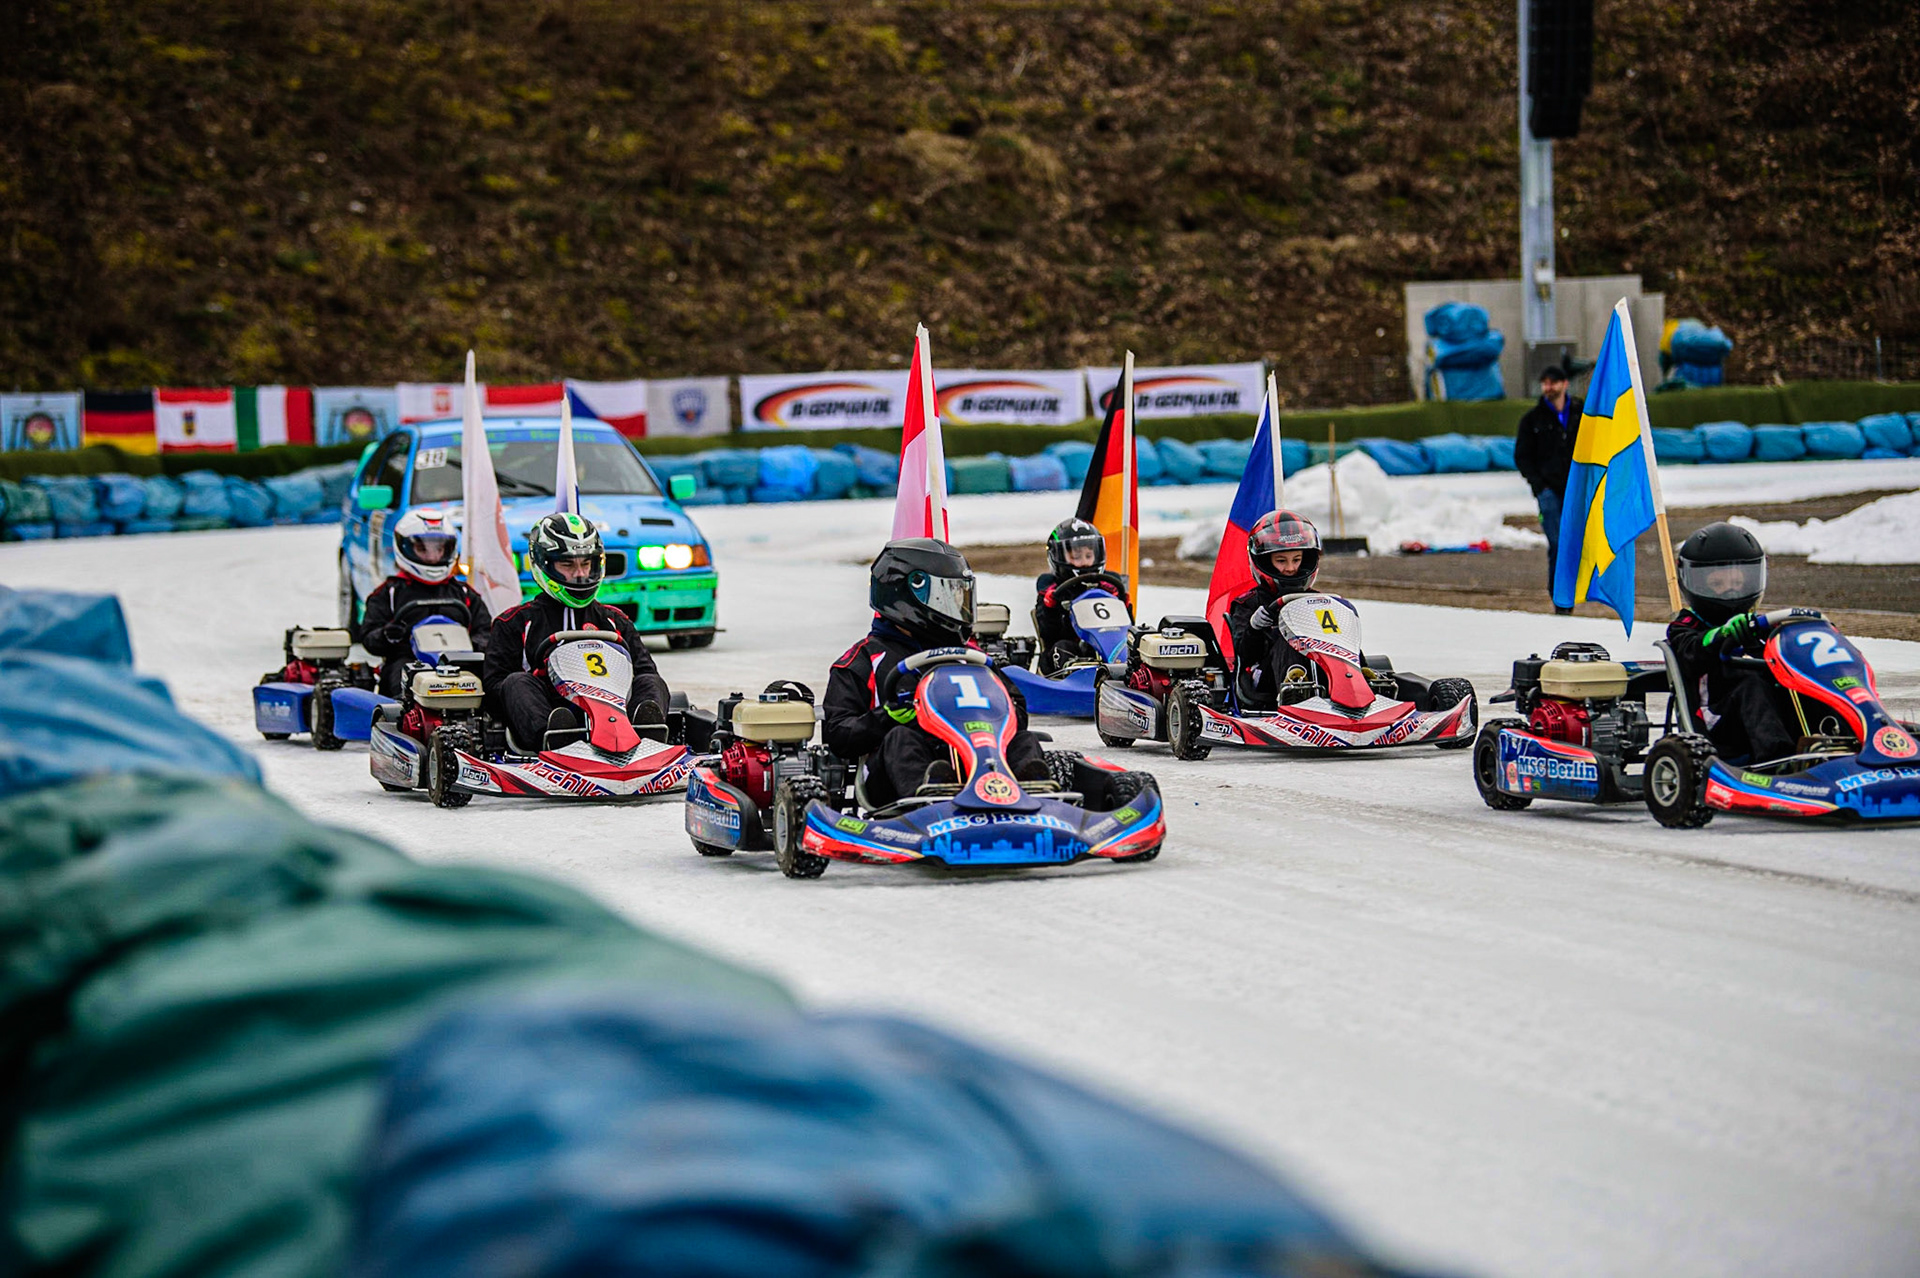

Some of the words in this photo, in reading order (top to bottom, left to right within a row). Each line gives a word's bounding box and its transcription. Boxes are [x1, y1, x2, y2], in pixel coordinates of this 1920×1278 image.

[1093, 602, 1110, 620] 6
[1322, 610, 1338, 633] 4
[1160, 645, 1198, 655] Mach1
[1796, 630, 1855, 668] 2
[586, 653, 608, 677] 3
[950, 675, 990, 709] 1
[1128, 711, 1149, 730] Mach1
[1206, 722, 1232, 734] Mach1
[463, 768, 490, 783] Mach1
[1518, 756, 1547, 777] MSC
[1548, 758, 1598, 781] Berlin
[1835, 768, 1896, 792] MSC
[926, 813, 989, 838] MSC
[993, 812, 1078, 835] Berlin
